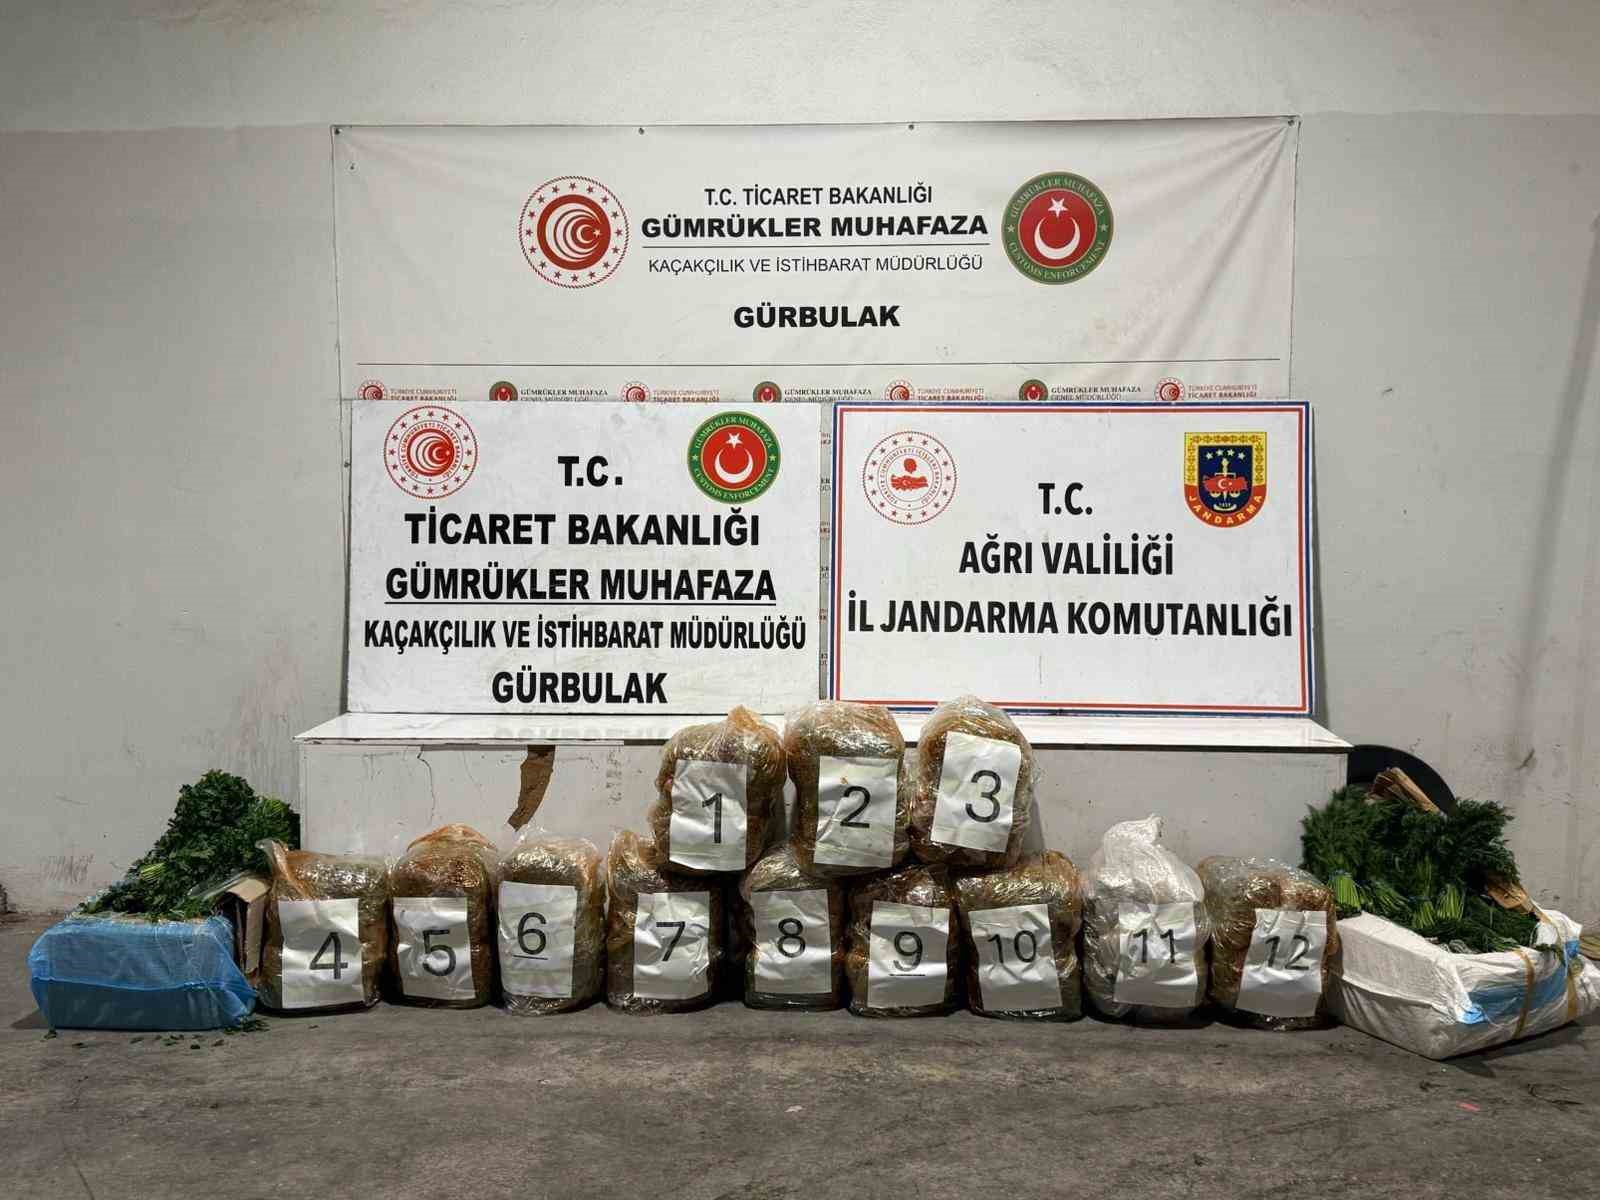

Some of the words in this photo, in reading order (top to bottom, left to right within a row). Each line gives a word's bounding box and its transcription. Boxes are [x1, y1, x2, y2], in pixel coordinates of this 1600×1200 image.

[704, 188, 737, 206] T.C.
[742, 183, 824, 206] TİCARET
[829, 182, 932, 205] BAKANLIĞI
[641, 213, 822, 238] GÜMRÜKLER
[831, 215, 989, 237] MUHAFAZA
[648, 258, 745, 277] KAÇAKÇILIK
[749, 258, 771, 273] VE
[776, 256, 872, 273] İSTİHBARAT
[876, 253, 983, 272] MÜDÜRLÜĞÜ
[733, 302, 901, 329] GÜRBULAK
[557, 455, 623, 488] T.C.
[1038, 482, 1093, 516] T.C.
[1189, 495, 1262, 524] JANDARMA
[404, 505, 557, 546] TİCARET
[568, 507, 759, 546] BAKANLIĞI
[958, 533, 1033, 574] AĞRI
[1041, 532, 1173, 576] VALİLİĞİ
[385, 561, 590, 601] GÜMRÜKLER
[600, 568, 777, 601] MUHAFAZA
[848, 589, 874, 632] İL
[879, 599, 1059, 634] JANDARMA
[1067, 595, 1292, 637] KOMUTANLIĞI
[364, 619, 497, 655] KAÇAKÇILIK
[502, 620, 530, 648] VE
[537, 613, 664, 650] İSTİHBARAT
[670, 615, 806, 650] MÜDÜRLÜĞÜ
[492, 664, 668, 704] GÜRBULAK
[840, 785, 872, 829] 2
[965, 769, 1002, 823] 3
[701, 792, 723, 844] 1
[420, 928, 457, 977] 5
[516, 911, 548, 956] 6
[655, 920, 687, 962] 7
[776, 917, 807, 959] 8
[892, 929, 924, 973] 9
[987, 929, 1038, 964] 10
[1131, 927, 1178, 964] 11
[1263, 934, 1311, 971] 12
[308, 930, 349, 980] 4
